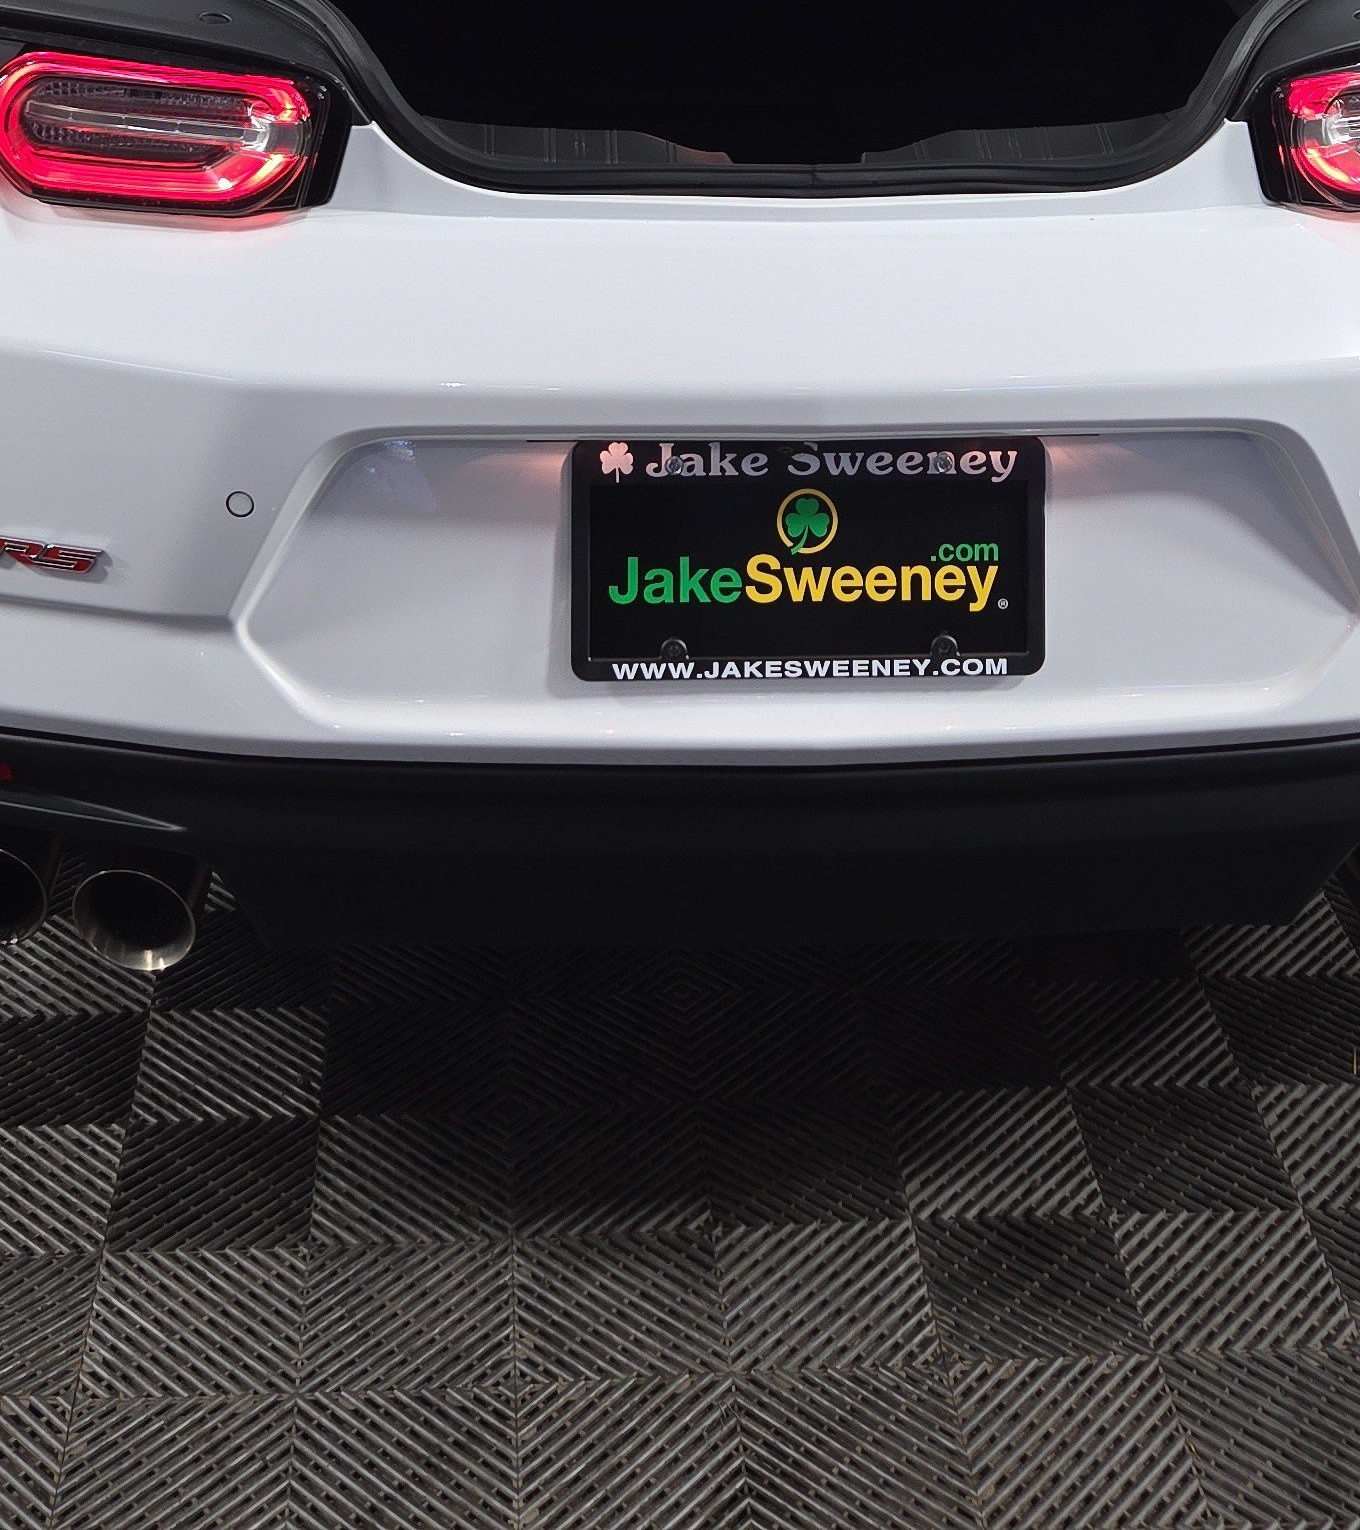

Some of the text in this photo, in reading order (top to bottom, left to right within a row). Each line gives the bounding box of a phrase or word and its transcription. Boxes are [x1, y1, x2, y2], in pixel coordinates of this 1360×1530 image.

[645, 441, 1018, 483] Jake Sweeney
[611, 657, 1009, 681] WWW.JAKESWEENEY.COM
